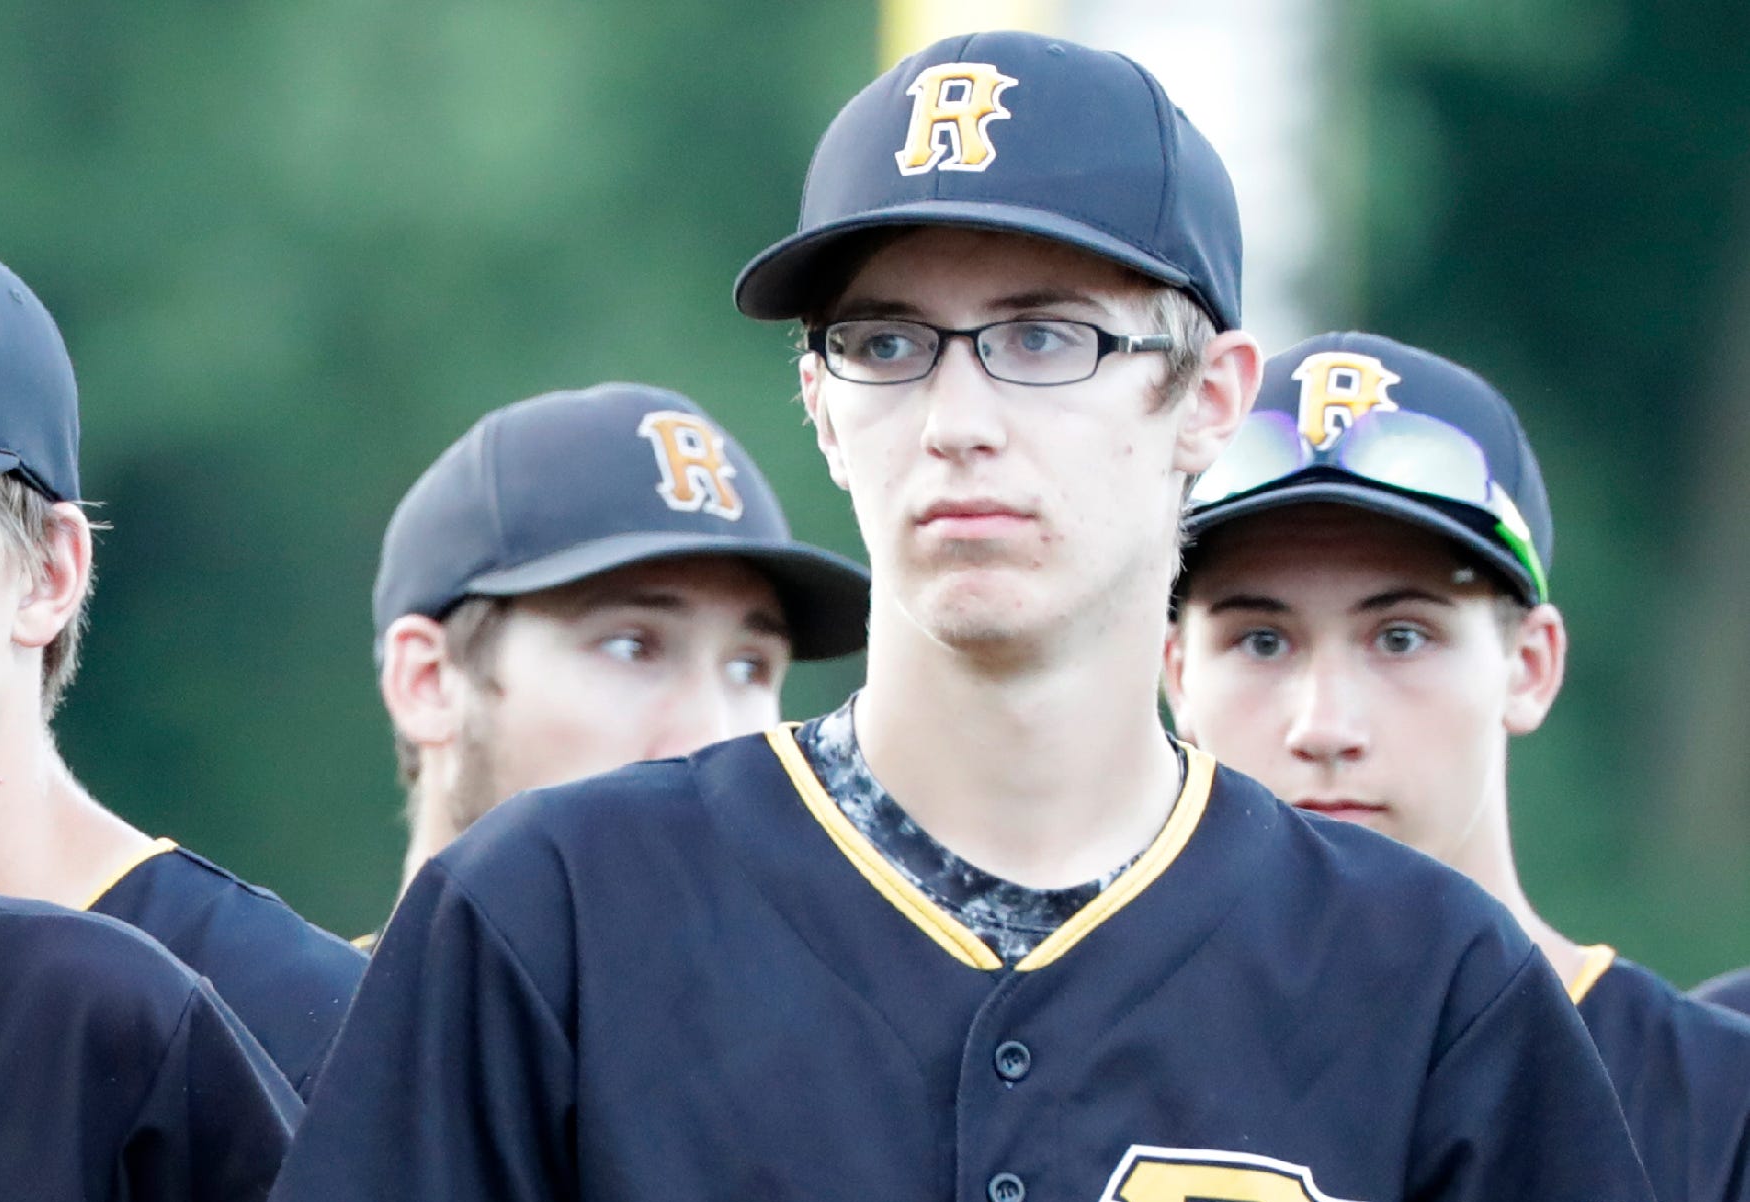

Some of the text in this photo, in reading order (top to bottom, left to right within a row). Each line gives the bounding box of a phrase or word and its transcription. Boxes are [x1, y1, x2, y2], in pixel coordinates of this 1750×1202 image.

[895, 62, 1019, 176] R
[1291, 351, 1401, 451] R
[638, 409, 745, 522] R
